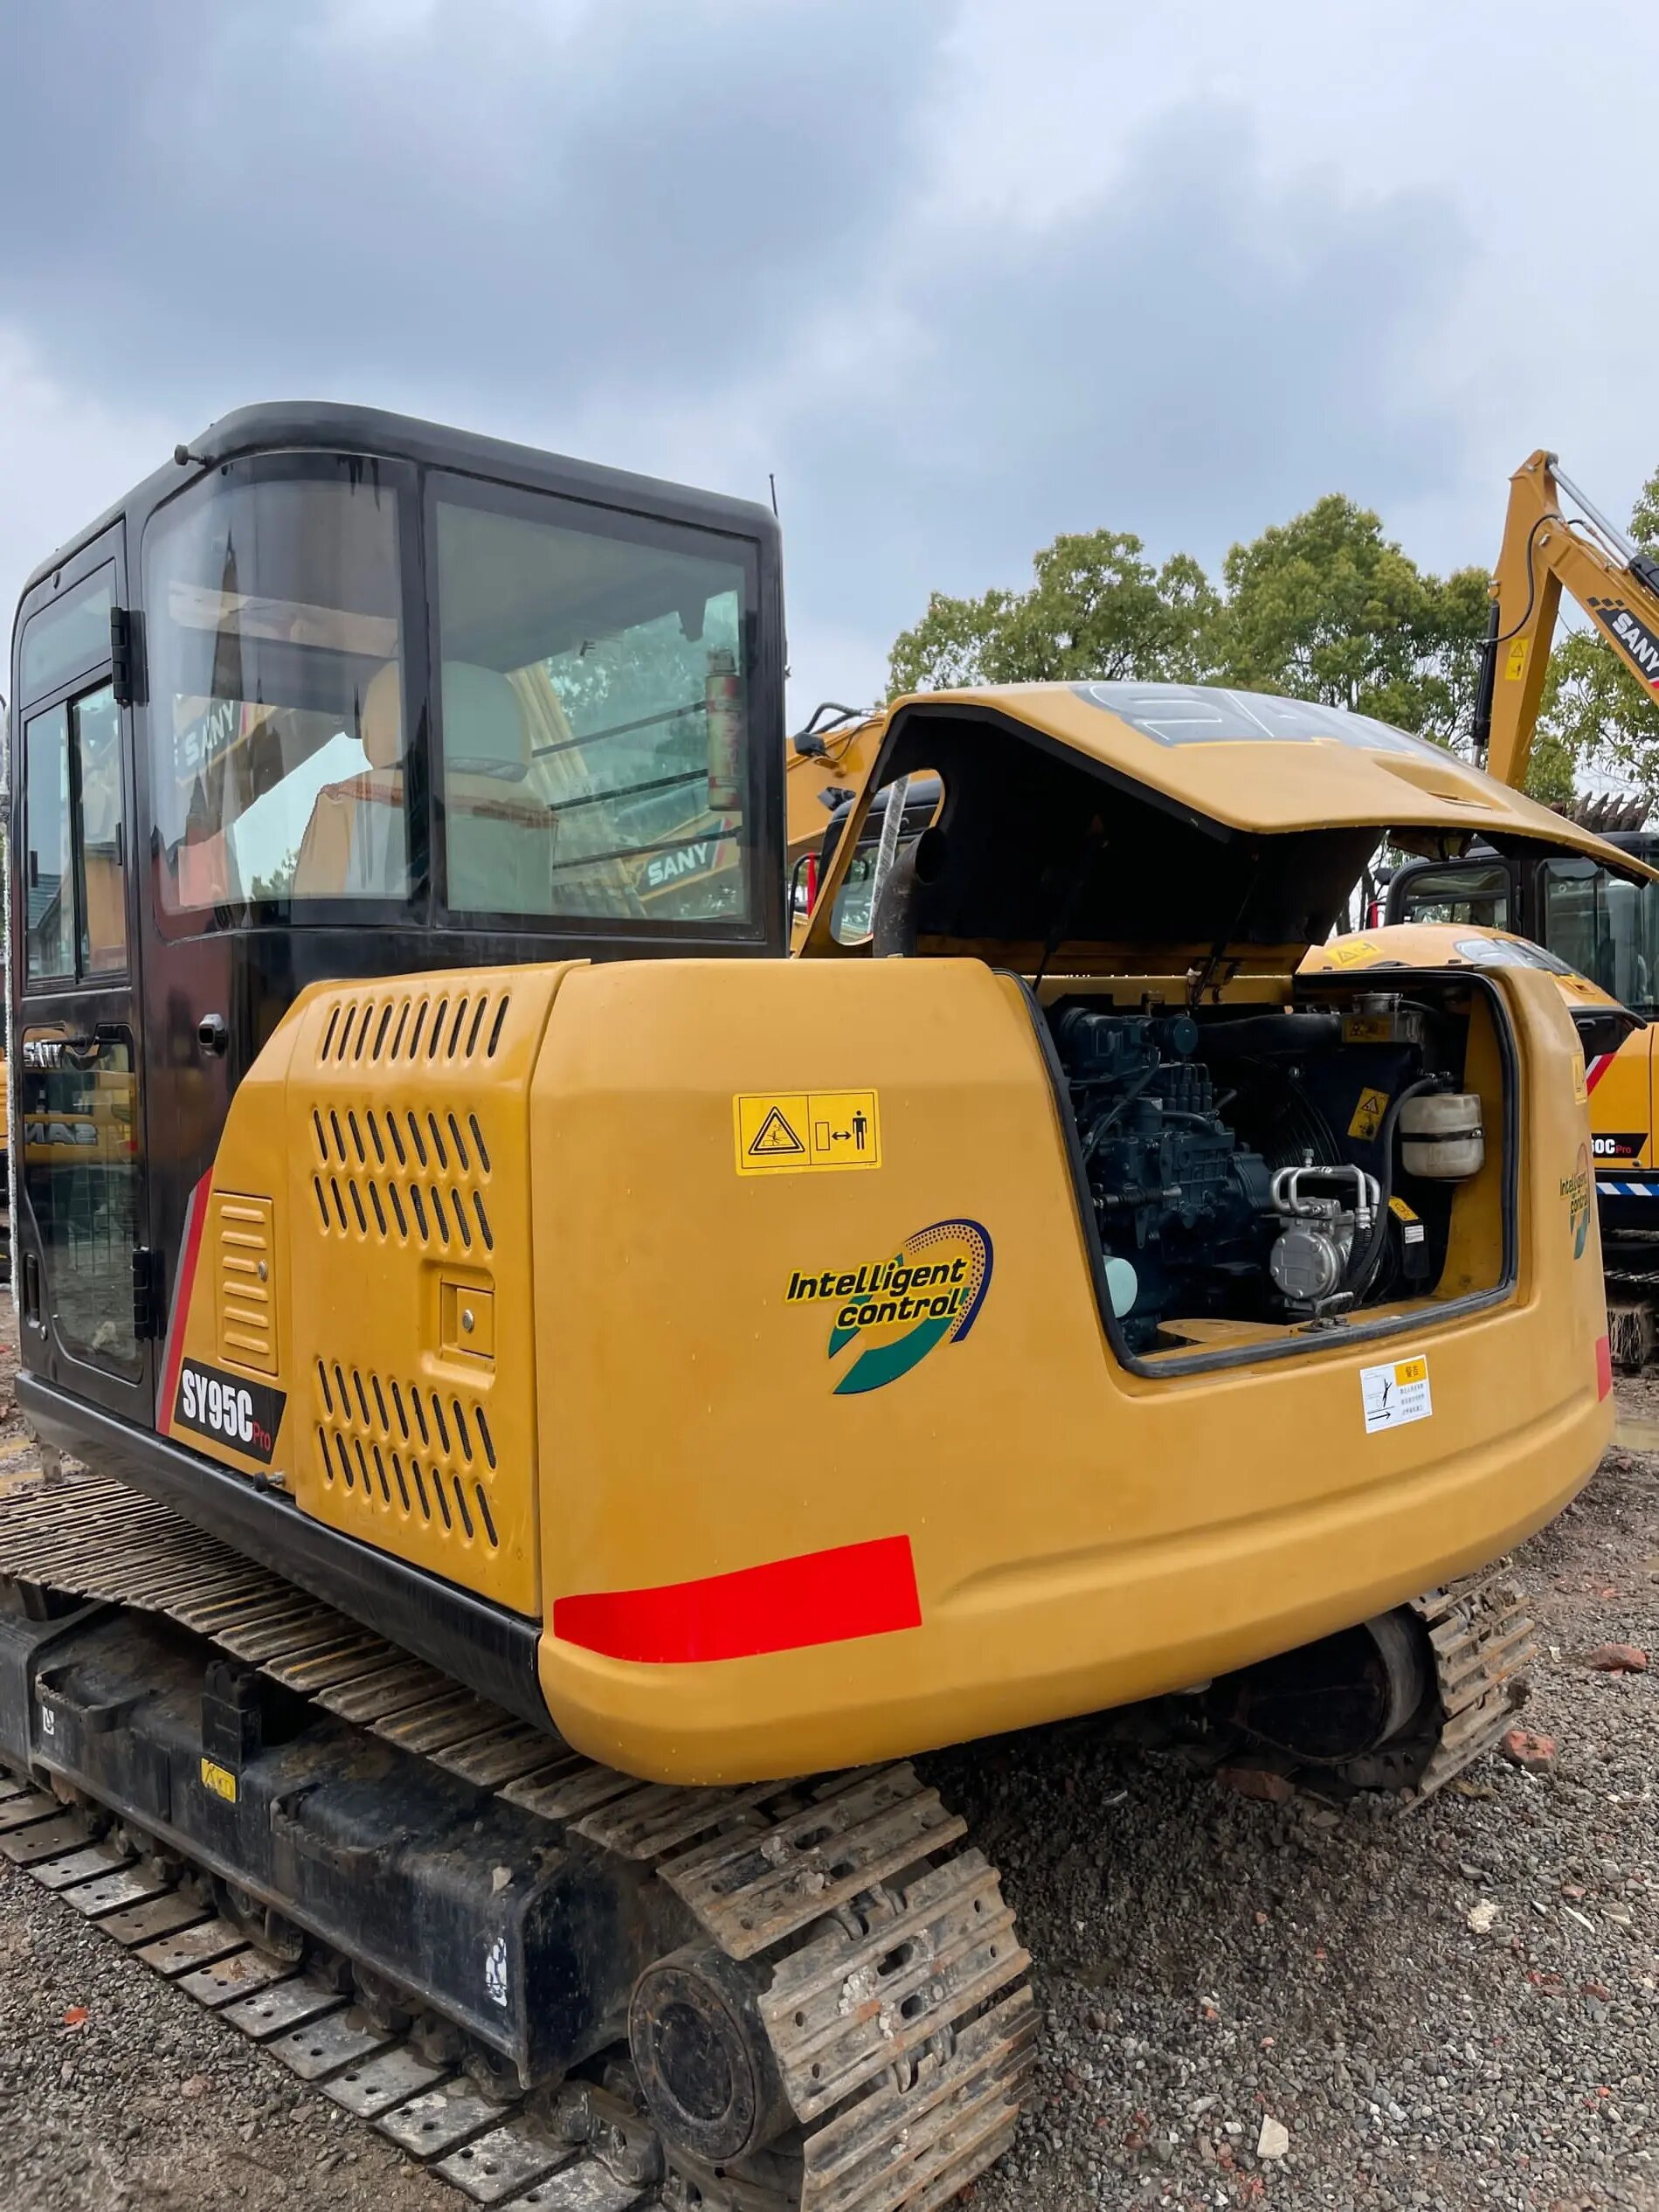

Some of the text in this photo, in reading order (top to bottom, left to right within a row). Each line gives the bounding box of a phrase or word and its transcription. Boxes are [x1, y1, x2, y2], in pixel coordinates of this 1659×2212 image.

[1612, 612, 1659, 673] SANY
[648, 841, 708, 887] SANY
[1615, 1144, 1632, 1154] Pro
[786, 1258, 967, 1300] Intelligent
[837, 1288, 960, 1327] control
[182, 1369, 272, 1451] SY95C Pro
